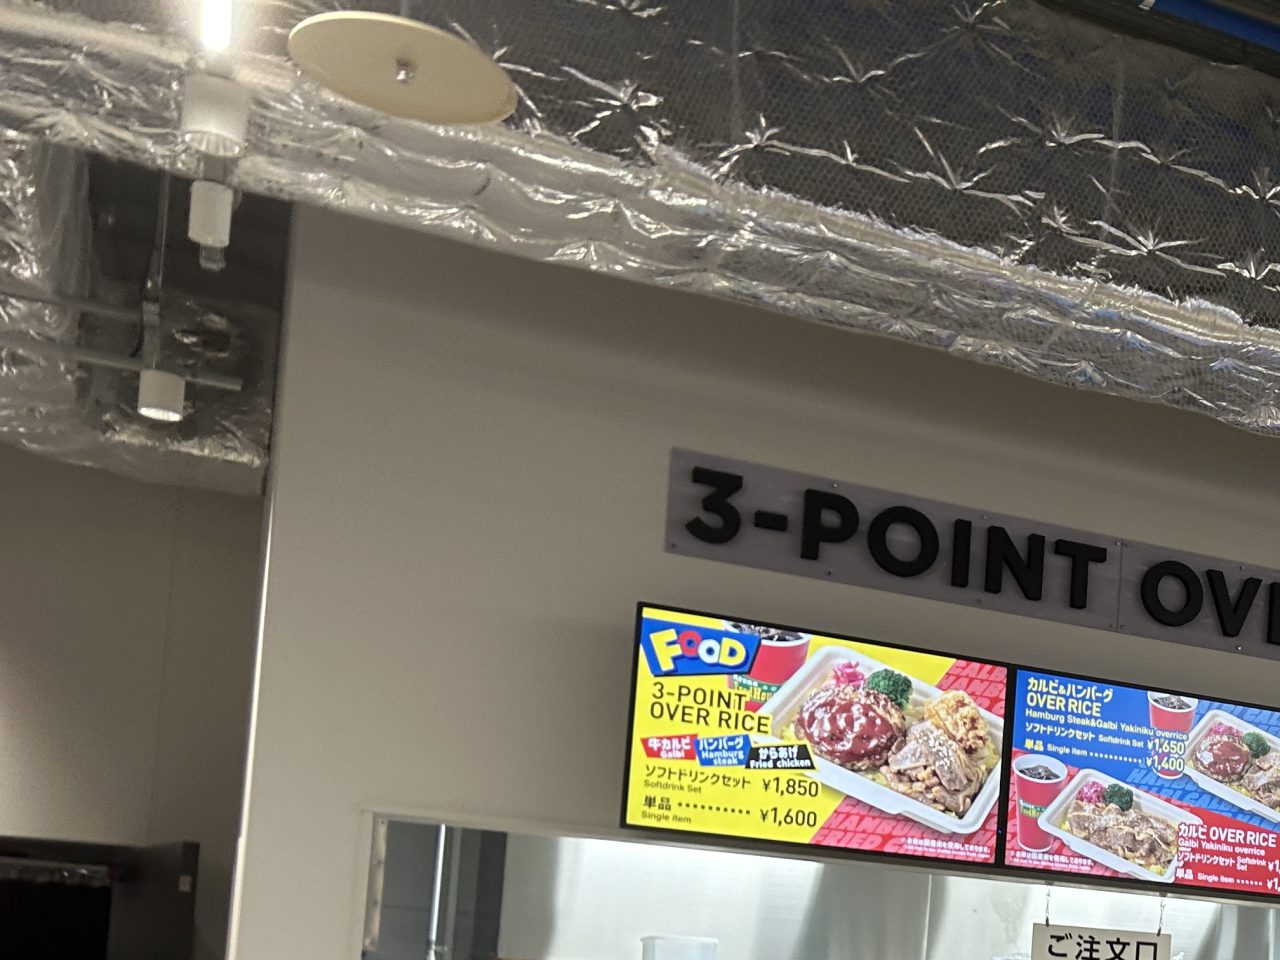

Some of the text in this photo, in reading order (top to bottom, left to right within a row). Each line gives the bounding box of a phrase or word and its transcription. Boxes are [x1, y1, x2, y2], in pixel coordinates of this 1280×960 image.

[684, 466, 1107, 609] 3-POINT
[652, 681, 746, 711] 3-POINT
[1027, 692, 1101, 717] OVER RICE
[650, 701, 770, 734] OVER RICE
[1026, 708, 1065, 724] Hamburg
[1120, 722, 1154, 736] Yakiniku
[1156, 728, 1188, 741] overrice
[648, 738, 691, 750] 牛カルビ
[699, 737, 744, 749] ハンバーグ
[1026, 722, 1185, 755] ソフトドリンクセット Softdrink Set ¥1,650
[660, 750, 685, 758] Galbi
[702, 750, 744, 760] Hamburg
[713, 757, 738, 765] steak
[759, 747, 799, 760] からあげ
[1024, 739, 1184, 771] 単品 Single item ¥1,400
[750, 758, 811, 769] Fried chicken
[644, 779, 702, 794] Softdrink Set
[645, 765, 819, 797] ソフトドリンクセット ¥1,850
[641, 811, 692, 823] Single item
[643, 795, 672, 811] 単品
[760, 807, 817, 828] ¥1,600
[1178, 824, 1207, 839] カルビ
[1210, 826, 1245, 844] OVER
[1247, 831, 1277, 847] RICE
[1178, 838, 1265, 856] Galbi Yakiniku overrice
[1178, 851, 1235, 867] ソフトドリンクセット
[1197, 872, 1219, 883] Single
